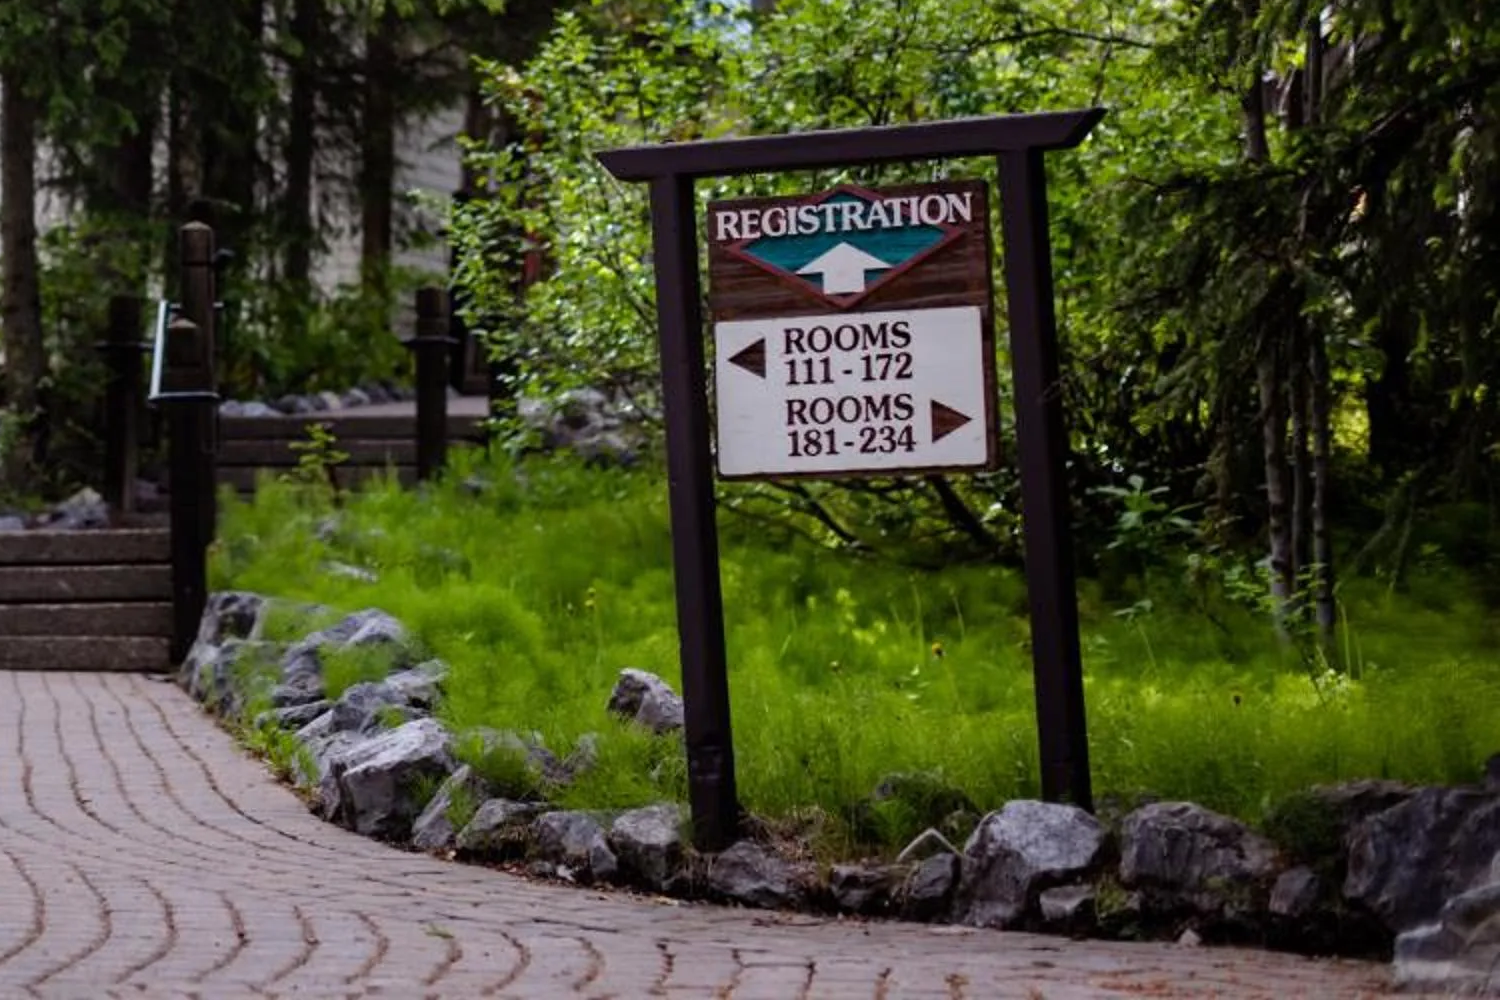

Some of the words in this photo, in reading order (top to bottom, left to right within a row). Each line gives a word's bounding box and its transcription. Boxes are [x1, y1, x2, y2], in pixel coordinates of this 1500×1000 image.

[715, 192, 972, 241] REGISTRATION
[783, 321, 911, 355] ROOMS
[786, 393, 914, 426] ROOMS
